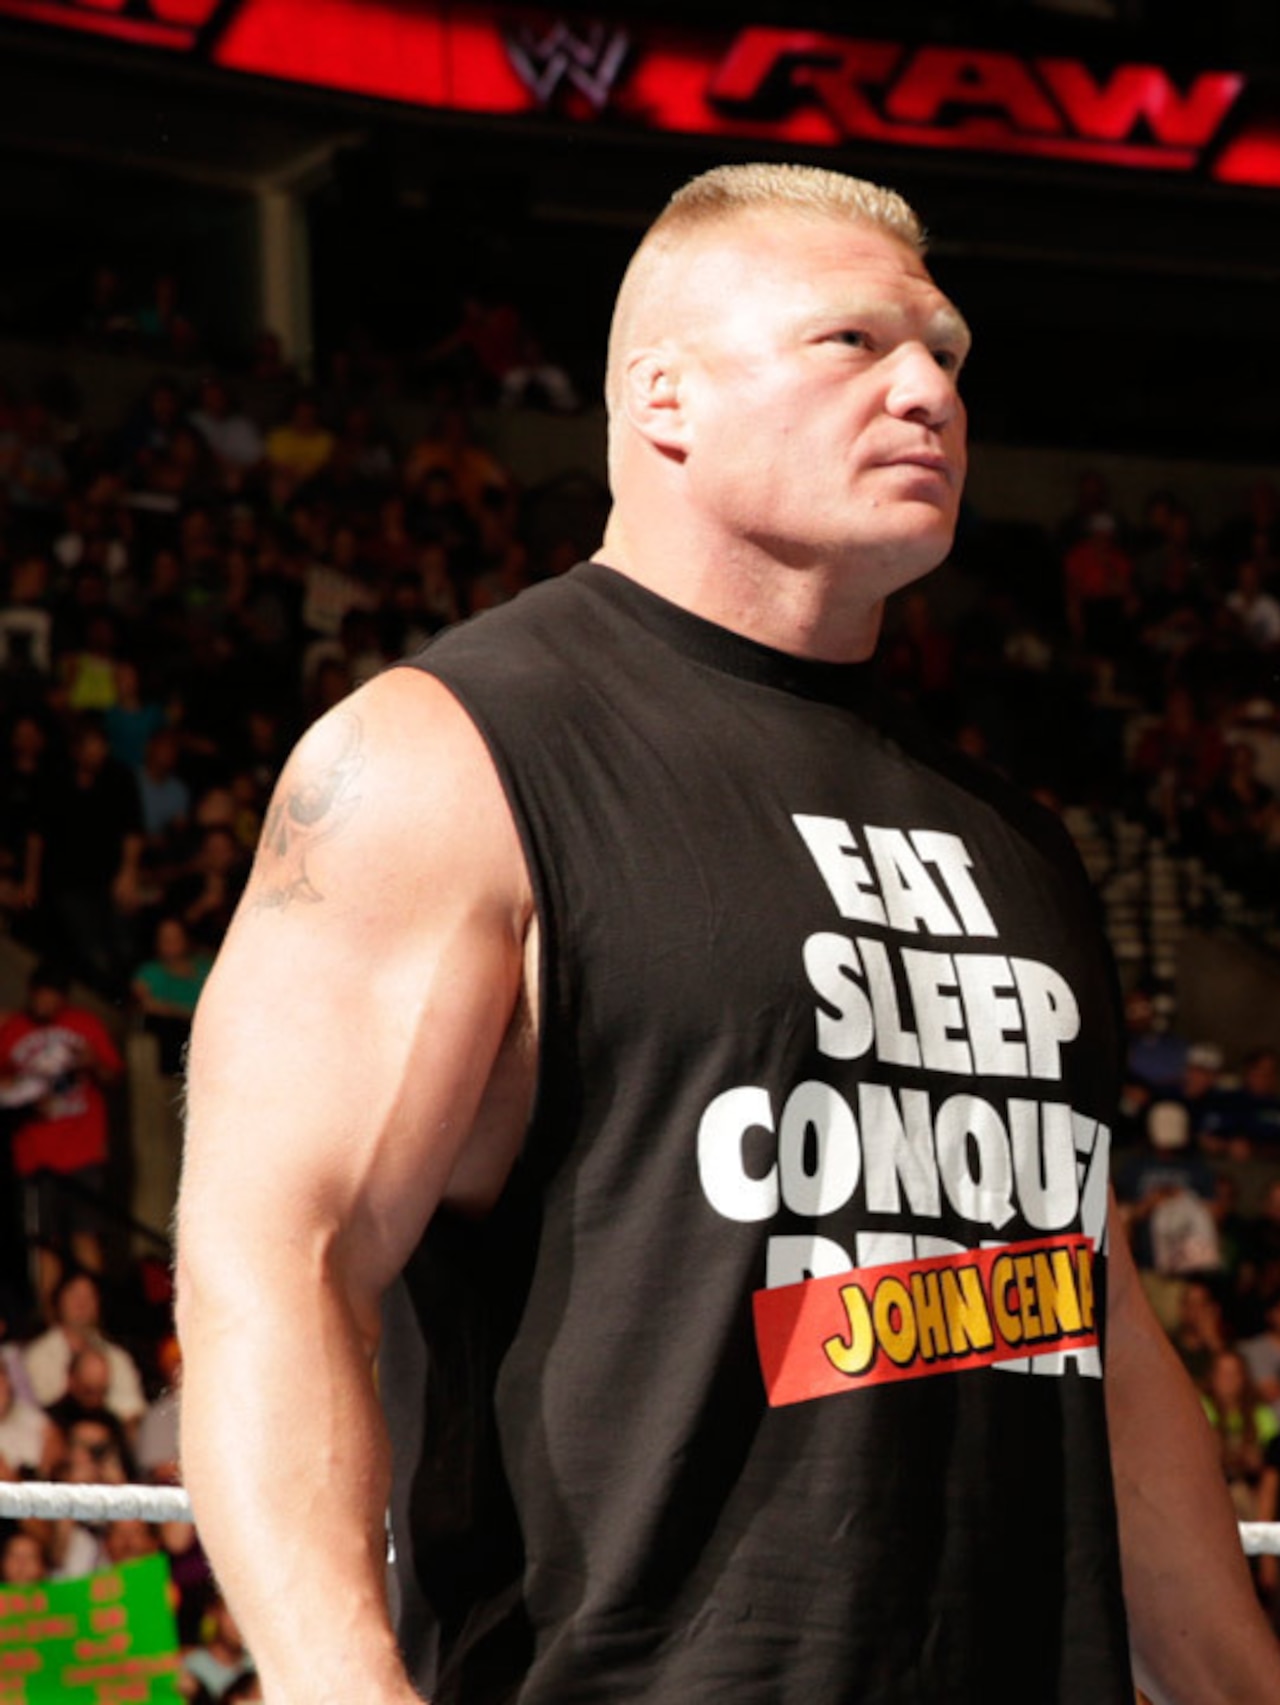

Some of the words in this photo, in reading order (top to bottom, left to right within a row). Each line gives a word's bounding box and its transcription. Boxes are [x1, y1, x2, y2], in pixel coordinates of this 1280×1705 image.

[710, 27, 1243, 155] RAW
[791, 813, 998, 937] EAT
[802, 931, 1081, 1081] SLEEP
[823, 1264, 995, 1377] JOHN
